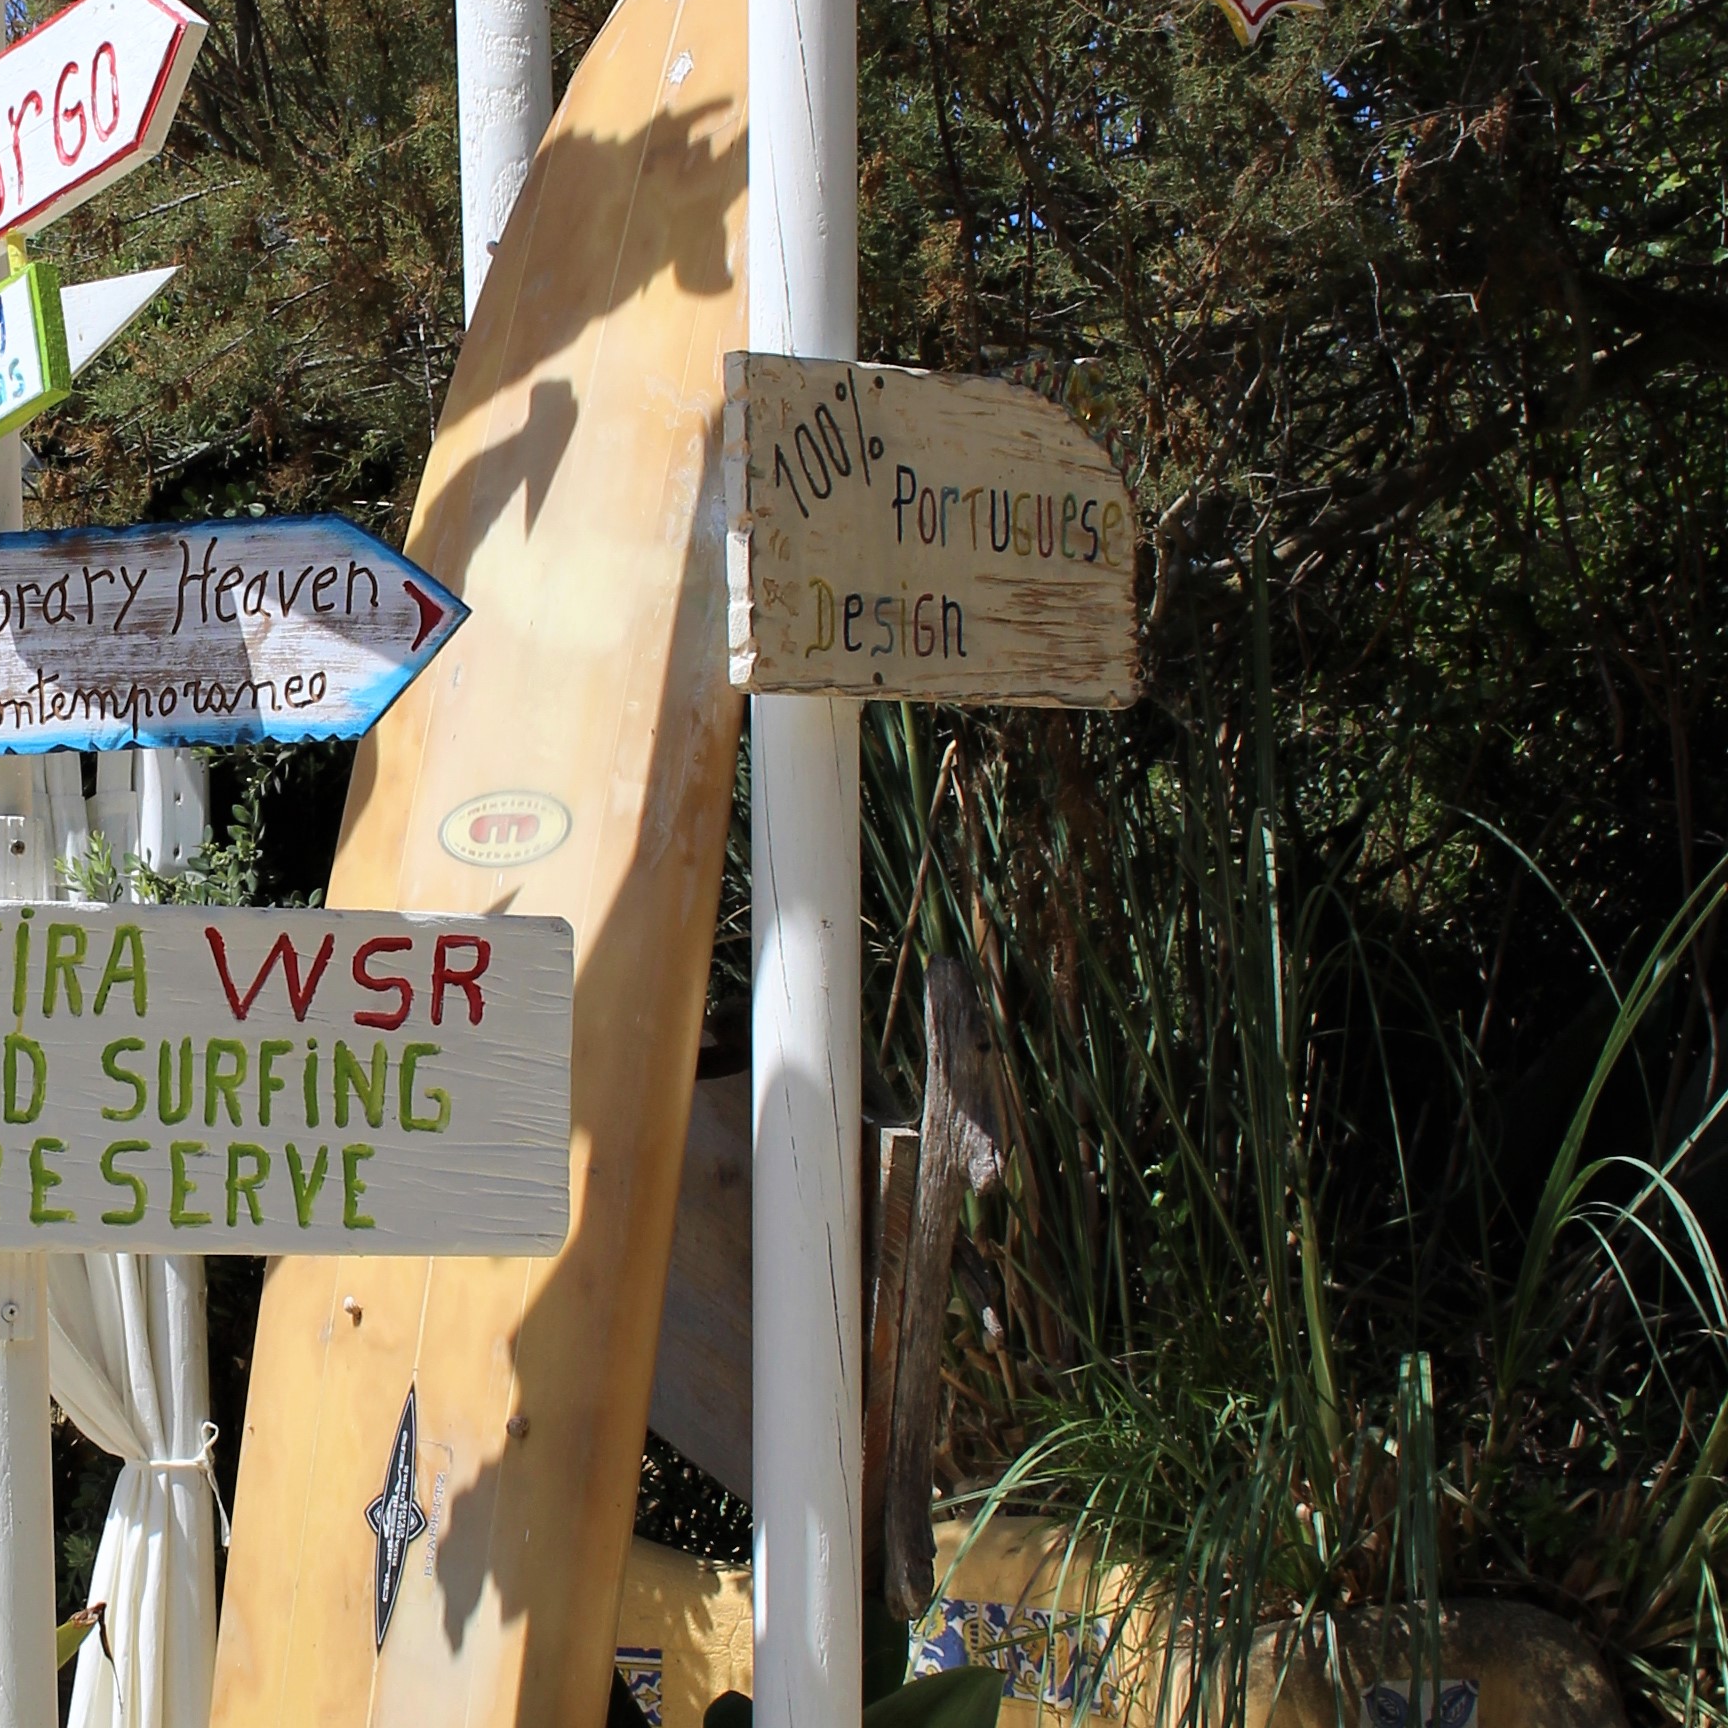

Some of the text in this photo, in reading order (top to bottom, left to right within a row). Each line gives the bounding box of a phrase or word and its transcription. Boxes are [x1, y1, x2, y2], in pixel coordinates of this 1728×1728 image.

[774, 368, 884, 519] 100%
[172, 537, 382, 635] Heaven
[205, 924, 493, 1030] WSR
